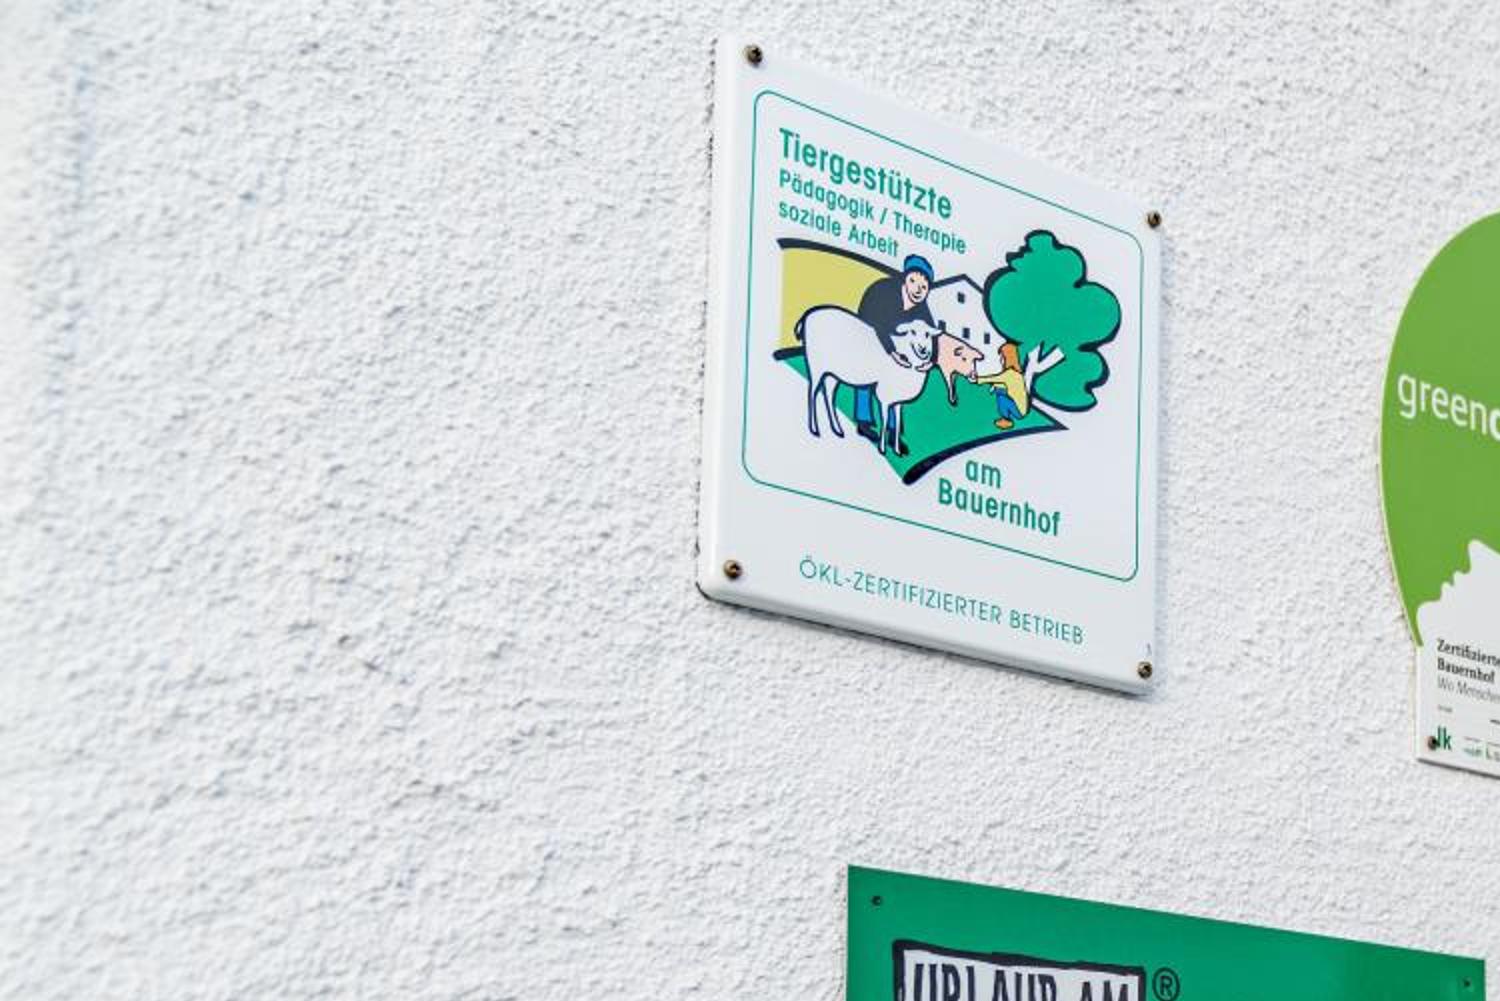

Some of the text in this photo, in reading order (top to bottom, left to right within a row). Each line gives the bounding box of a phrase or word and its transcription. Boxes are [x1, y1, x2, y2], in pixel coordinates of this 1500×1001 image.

[779, 127, 953, 221] Tiergestützte
[779, 168, 875, 222] Pädagogik
[893, 211, 967, 255] Therapie
[779, 200, 900, 258] soziale Arbeit
[965, 460, 1003, 488] am
[938, 477, 1061, 537] Bauernhof
[799, 555, 1085, 645] ÖKL-ZERTIFIZIERTER BETRIEB
[1437, 657, 1495, 683] Bauernhof
